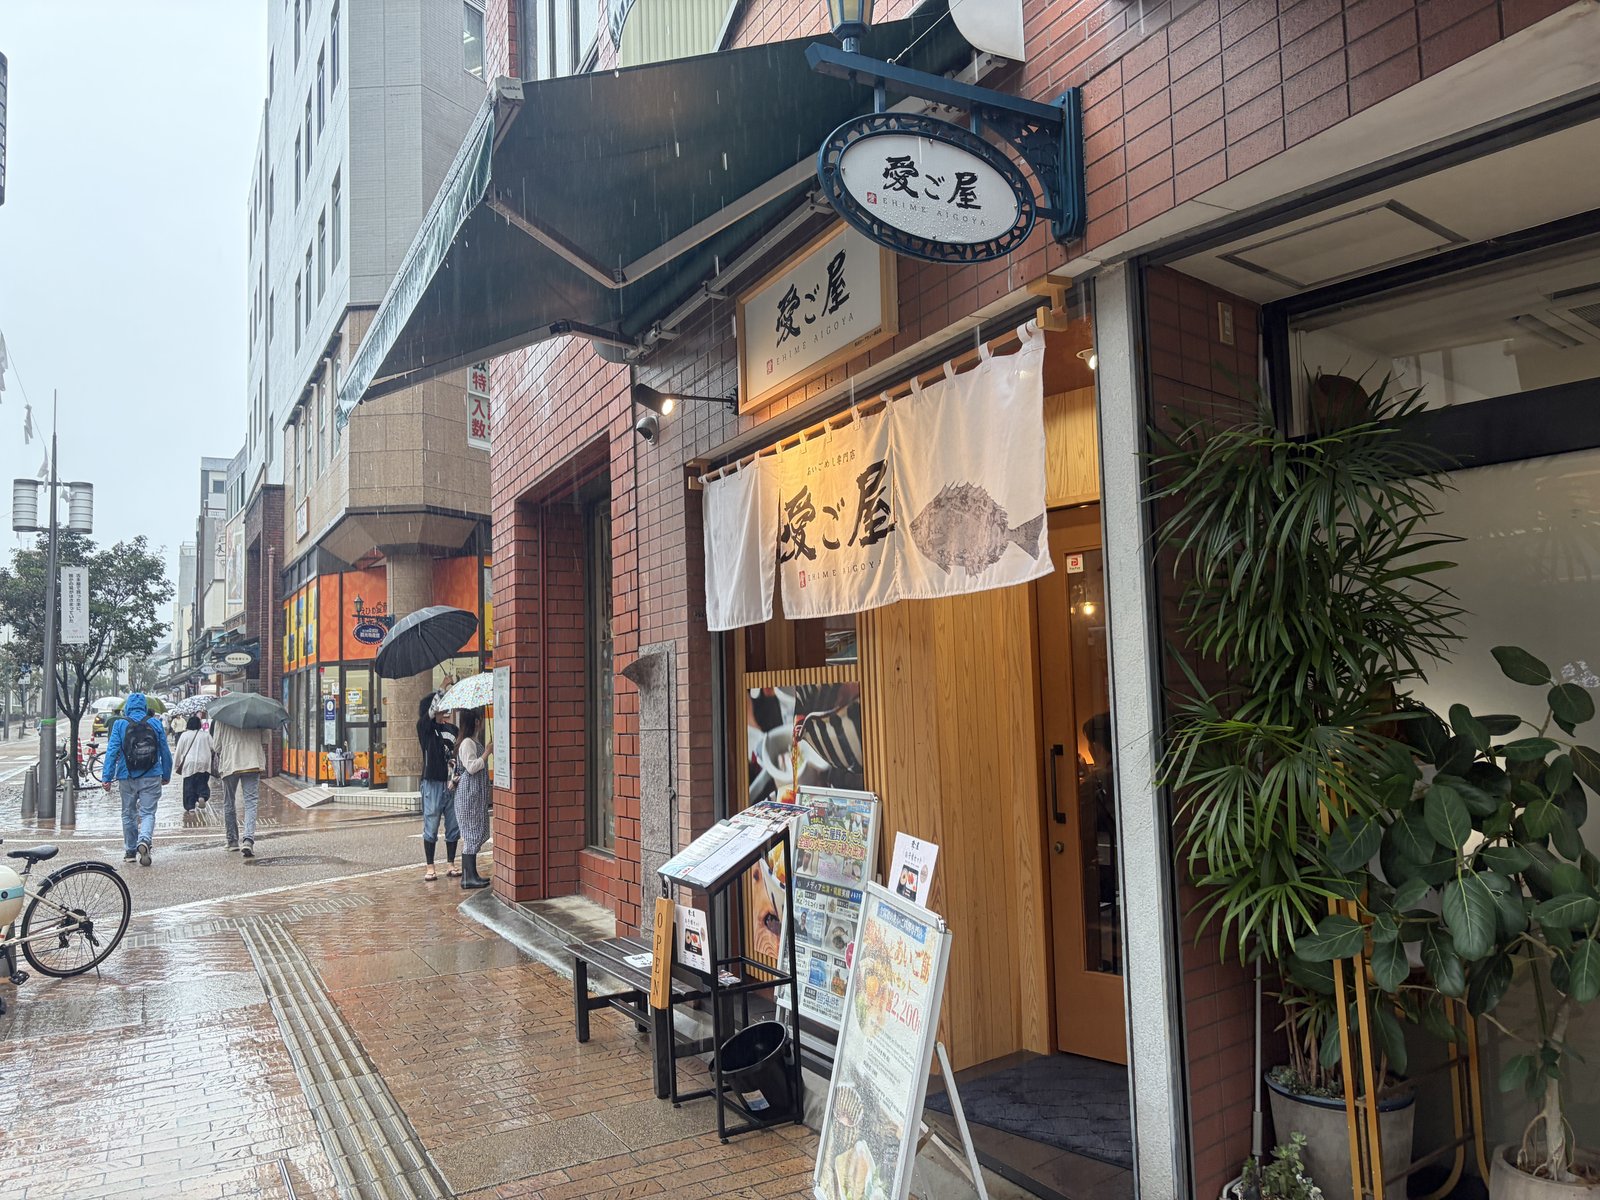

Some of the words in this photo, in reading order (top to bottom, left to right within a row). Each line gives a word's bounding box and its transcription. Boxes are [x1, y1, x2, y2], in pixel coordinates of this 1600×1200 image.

[882, 155, 982, 210] 愛ご屋
[882, 197, 928, 214] EHIME
[936, 210, 986, 227] AIGOYA
[776, 248, 851, 348] 愛ご屋
[775, 341, 807, 366] EHIME
[813, 312, 855, 343] AIGOYA
[807, 448, 856, 476] あいごめし専門店
[779, 458, 897, 564] 愛ご屋
[653, 912, 664, 996] OPEN
